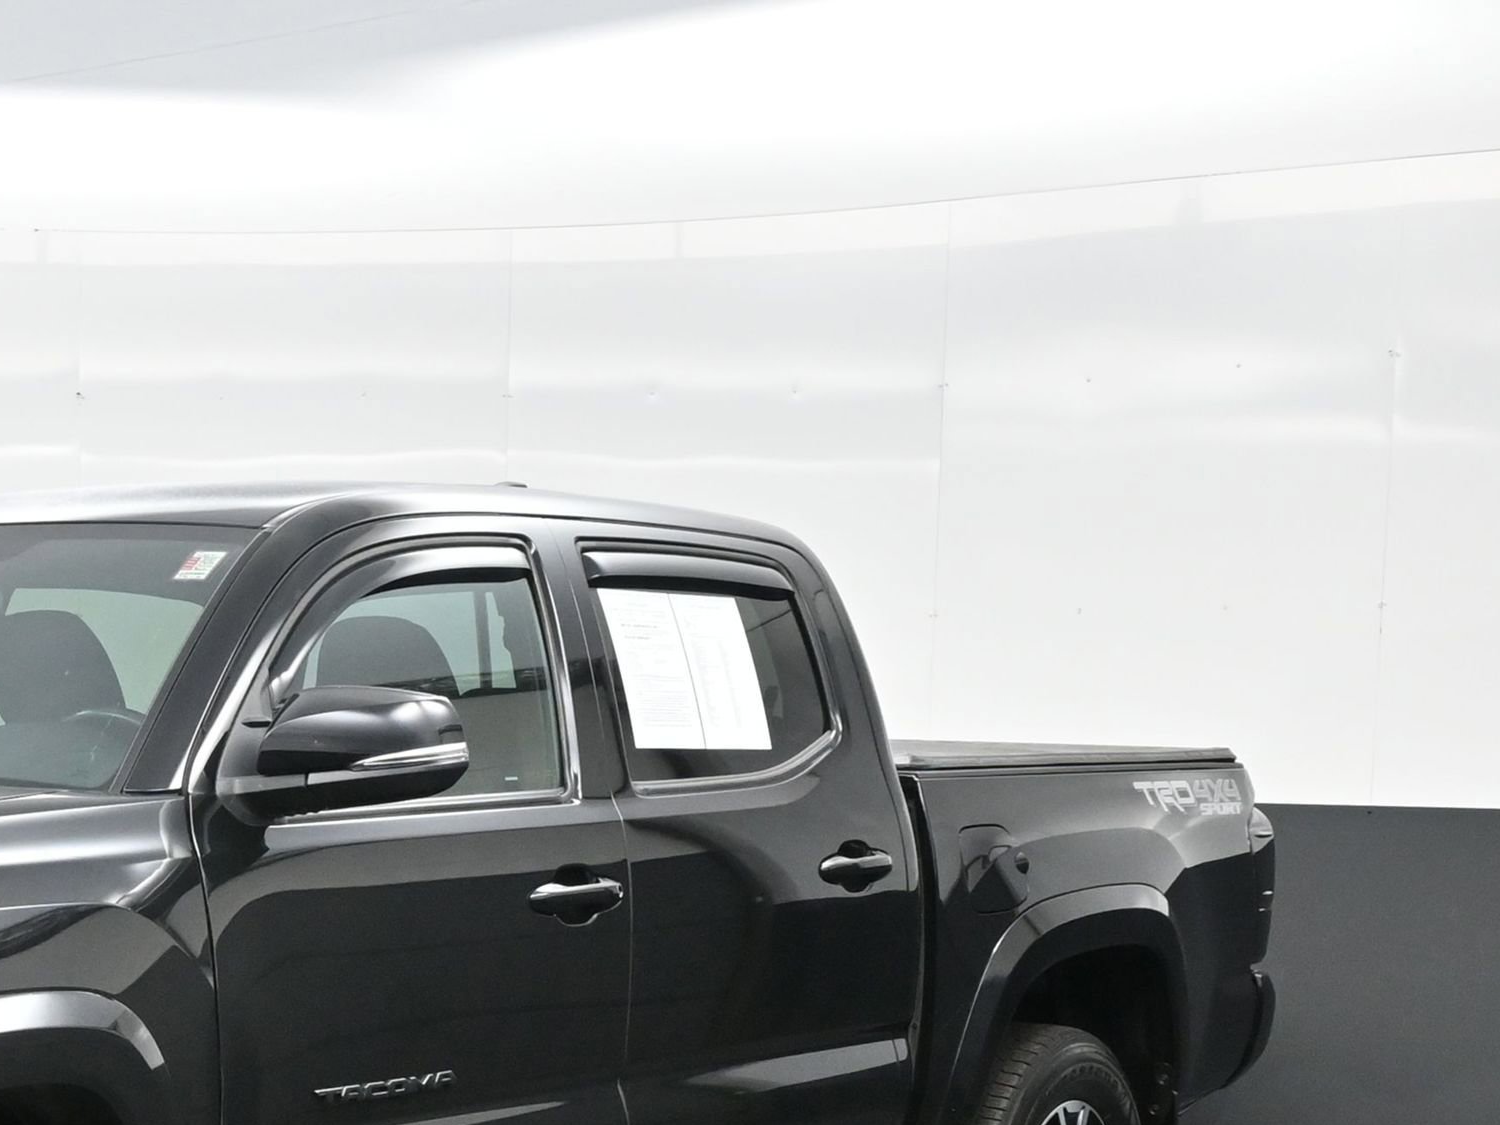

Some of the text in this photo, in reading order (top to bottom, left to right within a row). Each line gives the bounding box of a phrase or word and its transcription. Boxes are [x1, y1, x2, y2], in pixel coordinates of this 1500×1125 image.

[1133, 779, 1197, 814] TRD
[1200, 802, 1242, 815] SPORT
[314, 1070, 457, 1100] TACOMA
